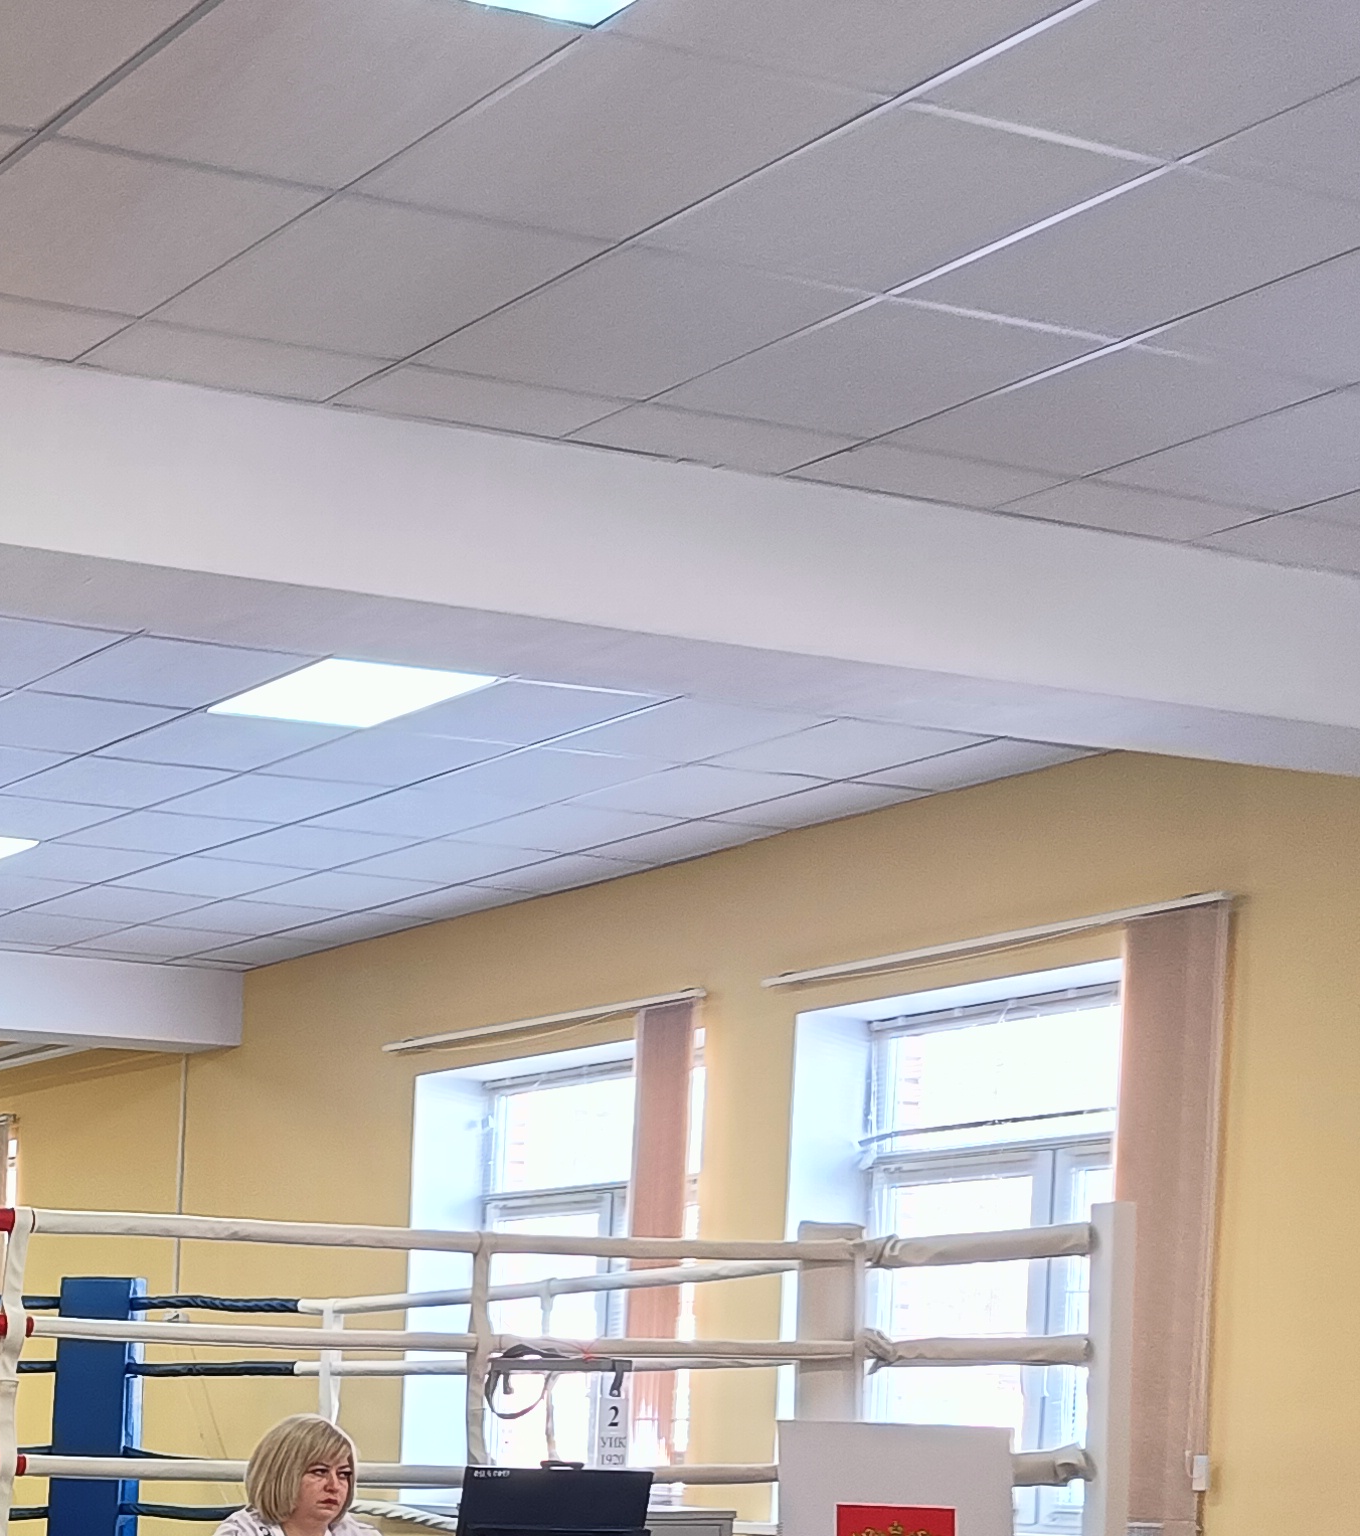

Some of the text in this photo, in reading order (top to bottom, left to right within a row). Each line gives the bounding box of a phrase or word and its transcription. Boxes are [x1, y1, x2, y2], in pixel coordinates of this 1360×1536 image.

[607, 1406, 620, 1427] 2
[600, 1435, 626, 1449] УИК
[600, 1453, 625, 1466] 1920
